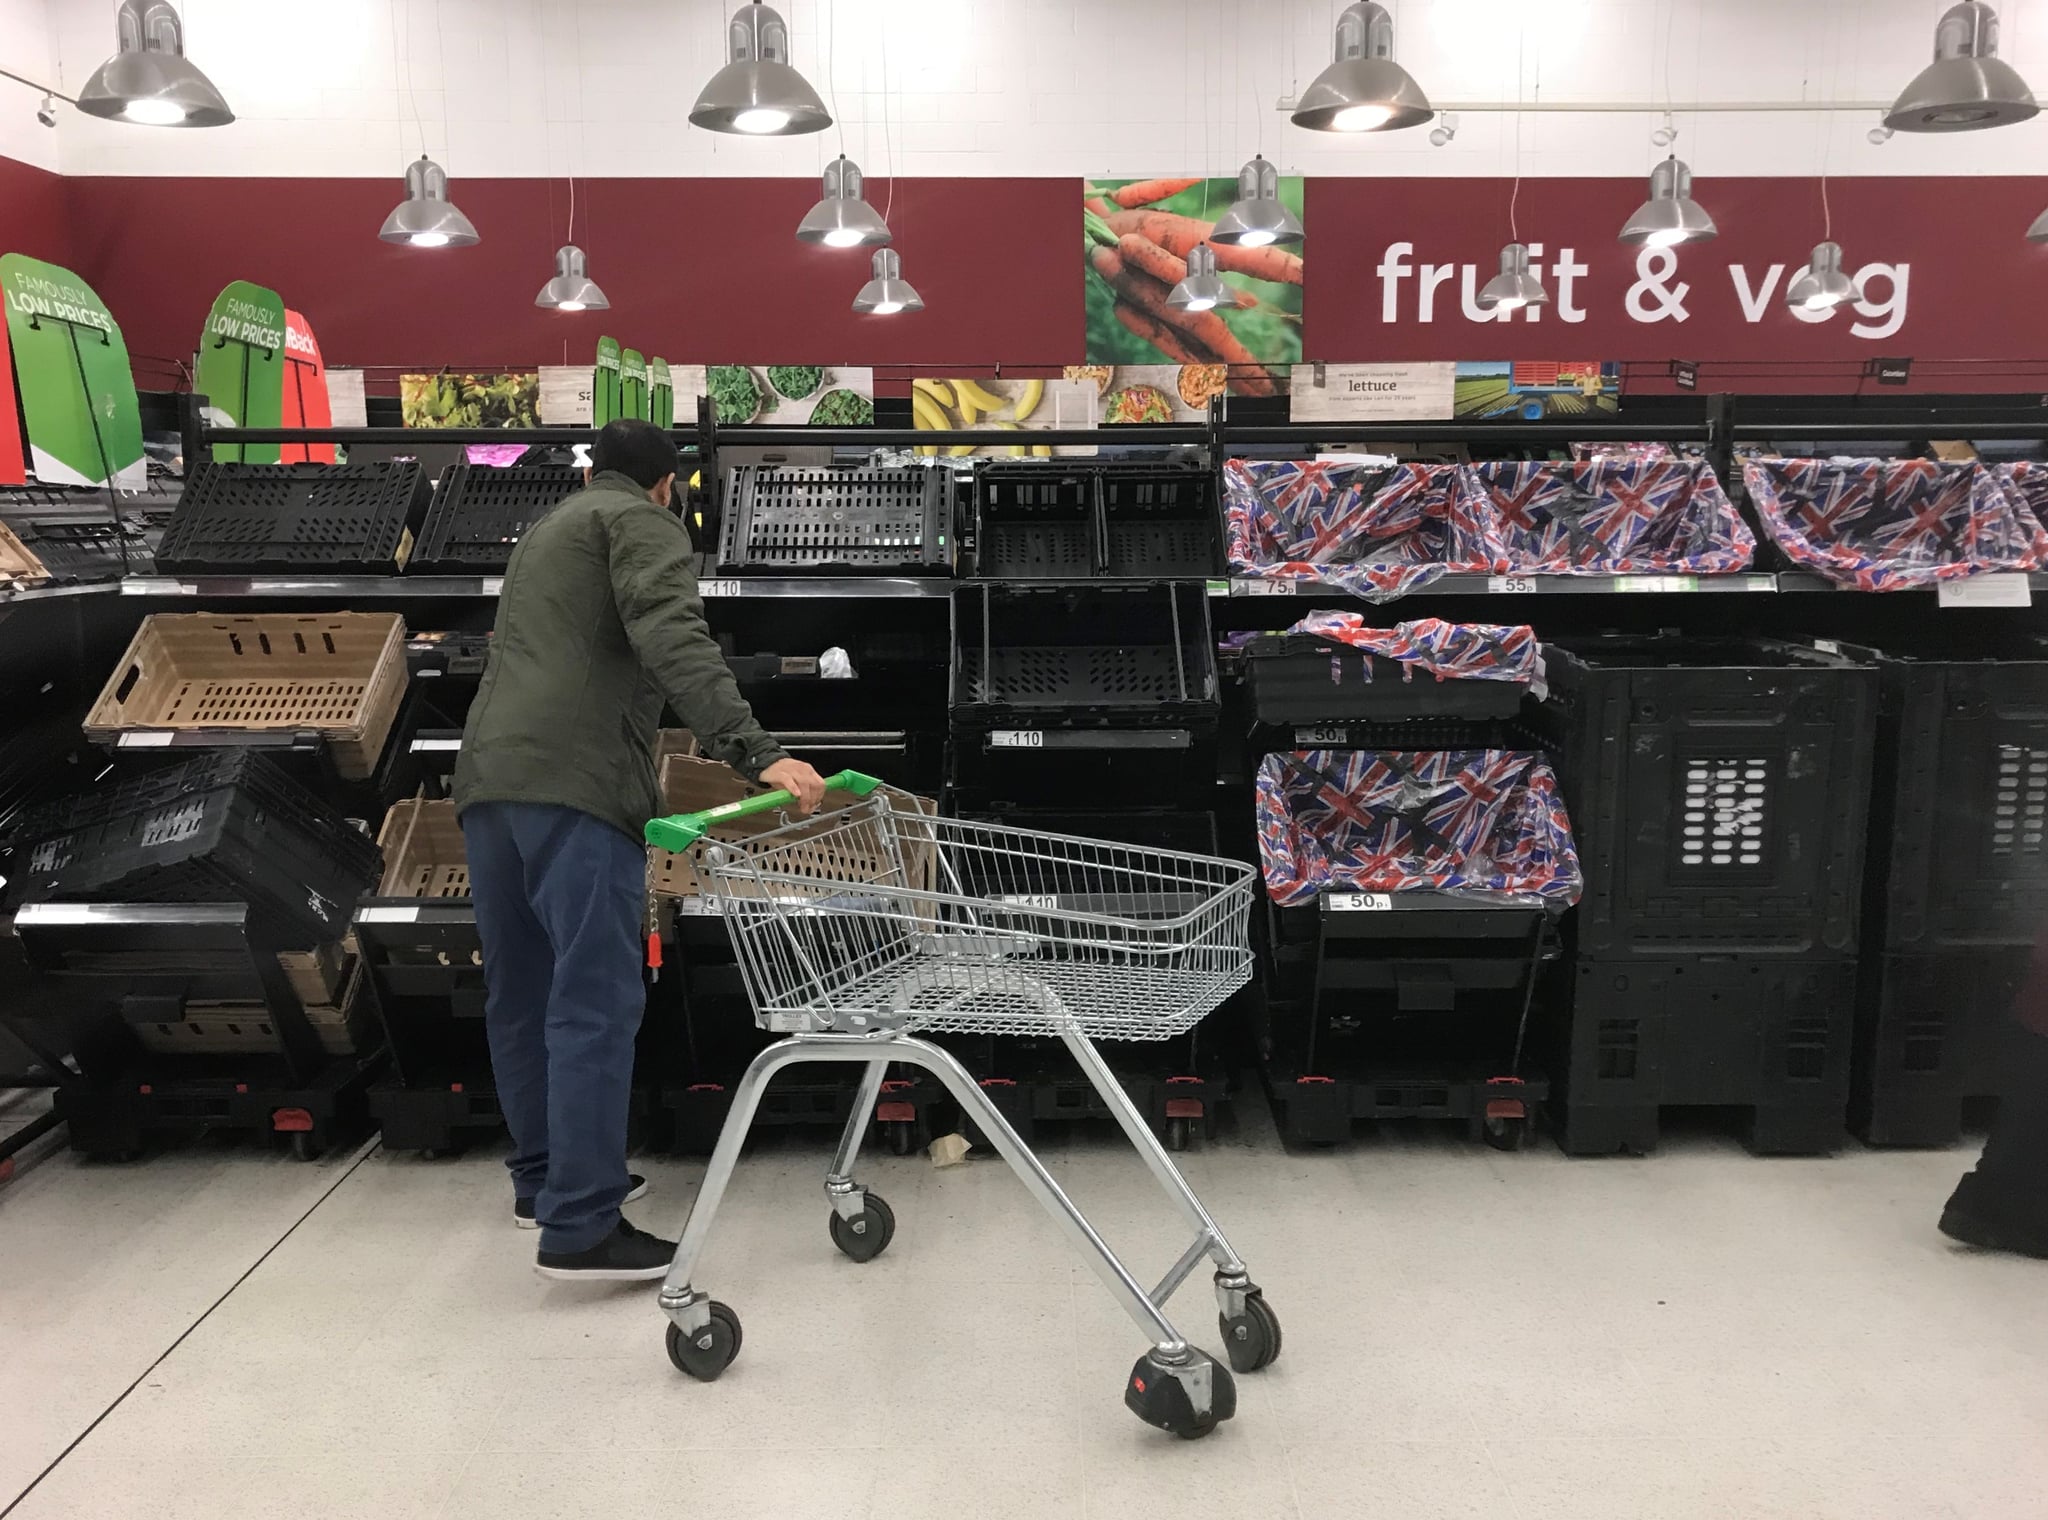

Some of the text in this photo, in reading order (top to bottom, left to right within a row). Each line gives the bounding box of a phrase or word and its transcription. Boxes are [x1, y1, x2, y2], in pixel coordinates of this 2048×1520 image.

[15, 272, 88, 306] FAMOUSLY
[1376, 241, 1588, 323] fruit
[1624, 245, 1691, 323] &
[8, 289, 112, 333] LOW PRICES
[226, 298, 276, 325] FAMOUSLY
[211, 314, 280, 350] LOW PRICES
[1349, 380, 1397, 392] lettuce
